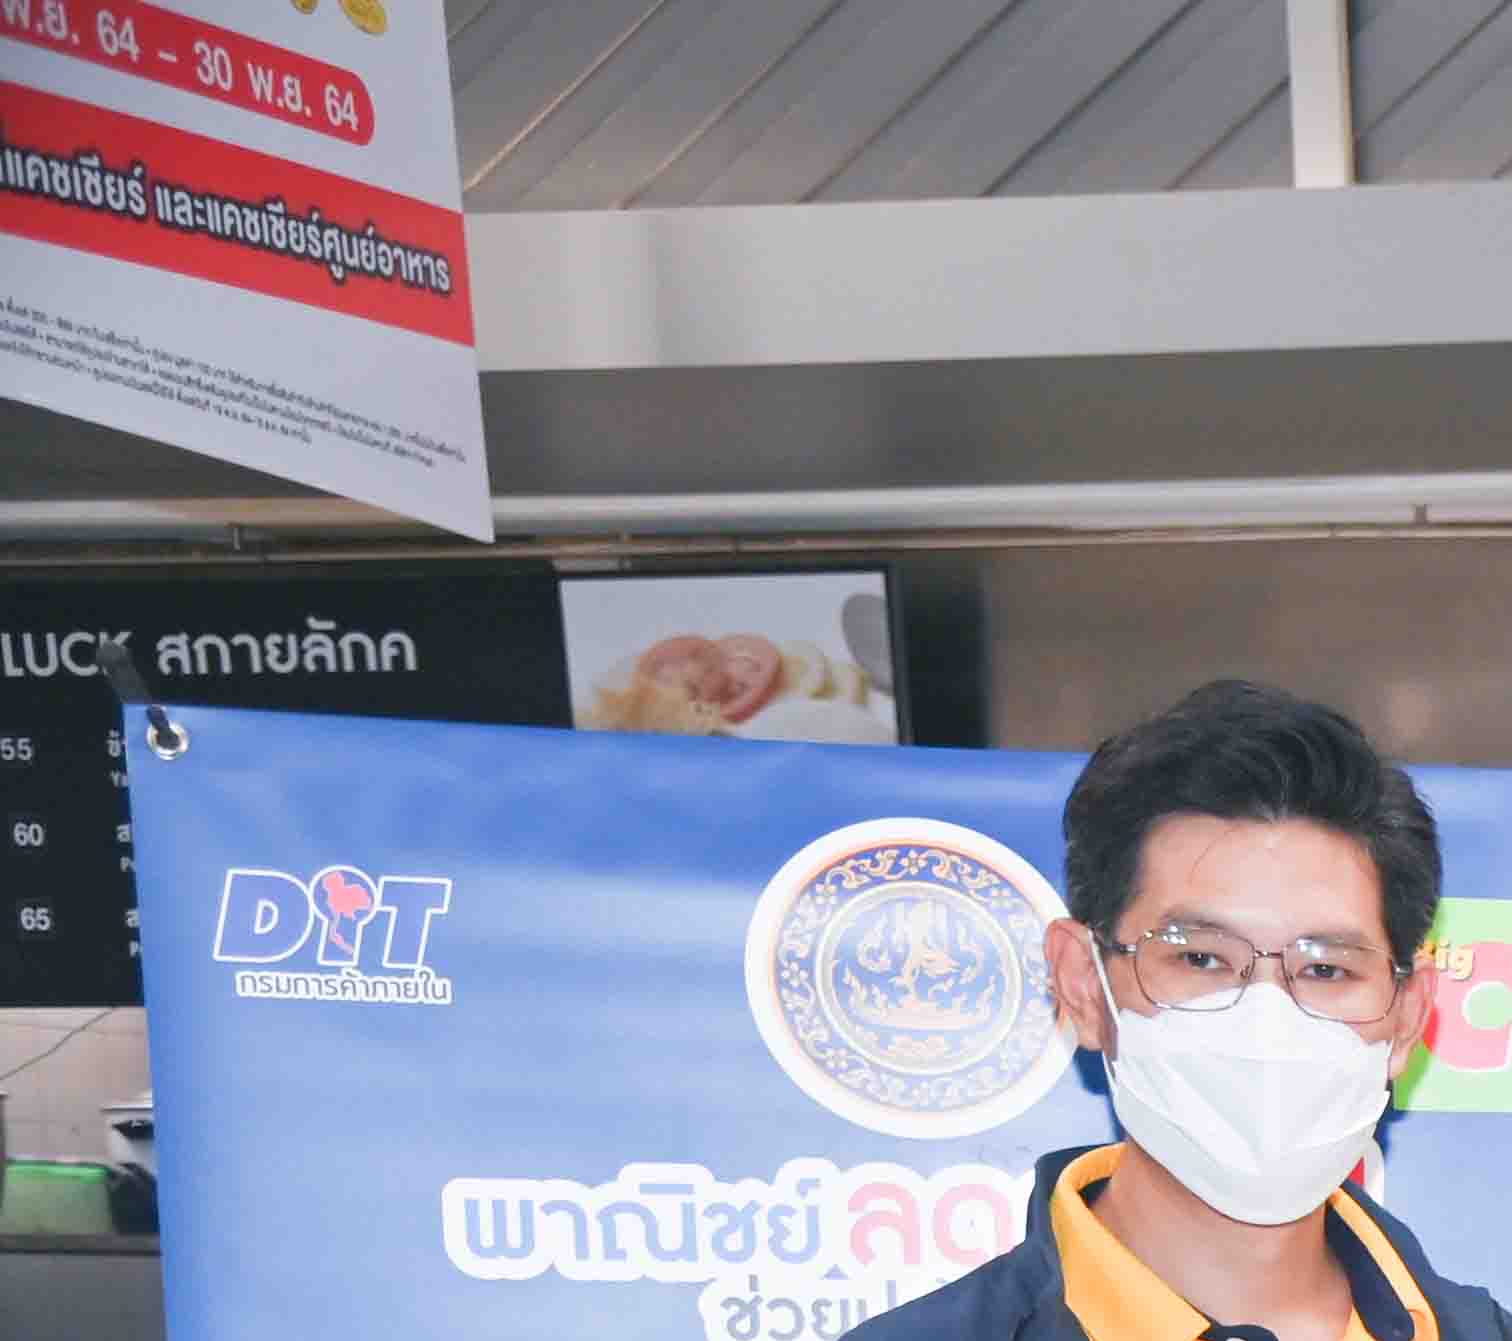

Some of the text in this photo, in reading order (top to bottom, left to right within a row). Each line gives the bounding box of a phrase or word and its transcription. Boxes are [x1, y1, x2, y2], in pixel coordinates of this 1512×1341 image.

[96, 11, 140, 62] 64
[193, 41, 234, 91] 30
[248, 62, 312, 117] พ.ย.
[323, 84, 359, 131] 64
[156, 616, 417, 675] สกายลักค
[0, 738, 33, 761] 55
[13, 823, 44, 846] 60
[20, 907, 51, 931] 65
[236, 967, 451, 1004] กรมการค้าภายใน
[465, 1178, 821, 1262] พาณิชย์
